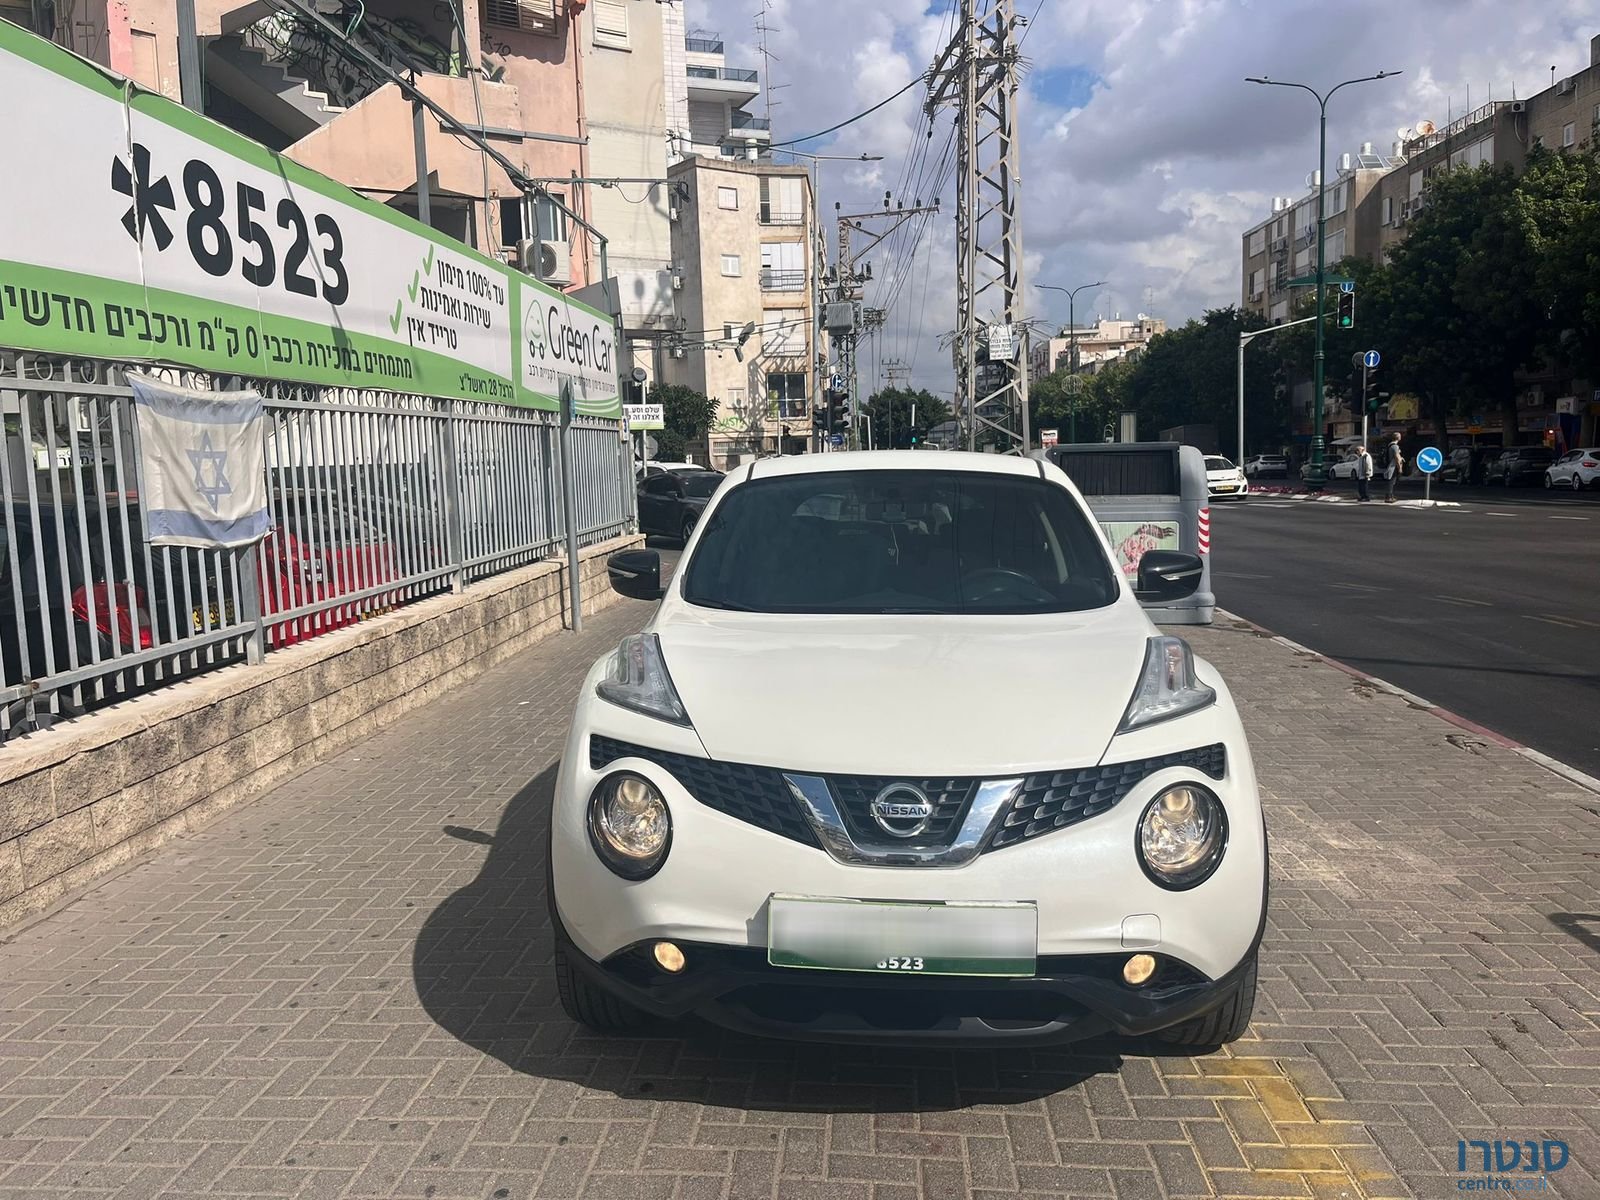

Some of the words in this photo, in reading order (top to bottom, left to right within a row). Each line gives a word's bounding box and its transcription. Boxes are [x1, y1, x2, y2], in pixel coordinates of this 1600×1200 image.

[437, 259, 464, 289] מימון
[466, 269, 491, 300] 100%
[0, 285, 95, 333] חדשי
[420, 286, 461, 320] ואמינות
[492, 284, 504, 306] עד
[104, 303, 191, 348] ורכבים
[463, 301, 491, 329] שירות
[246, 325, 258, 358] 0
[407, 316, 426, 347] אין
[428, 322, 457, 349] טרייד
[548, 305, 592, 368] Green
[592, 324, 612, 374] Car
[263, 334, 303, 365] רכבי
[306, 341, 361, 372] במכירת
[364, 351, 412, 379] מתמחים
[488, 379, 498, 396] 28
[498, 379, 514, 399] הרצל
[877, 805, 928, 816] NISSAN
